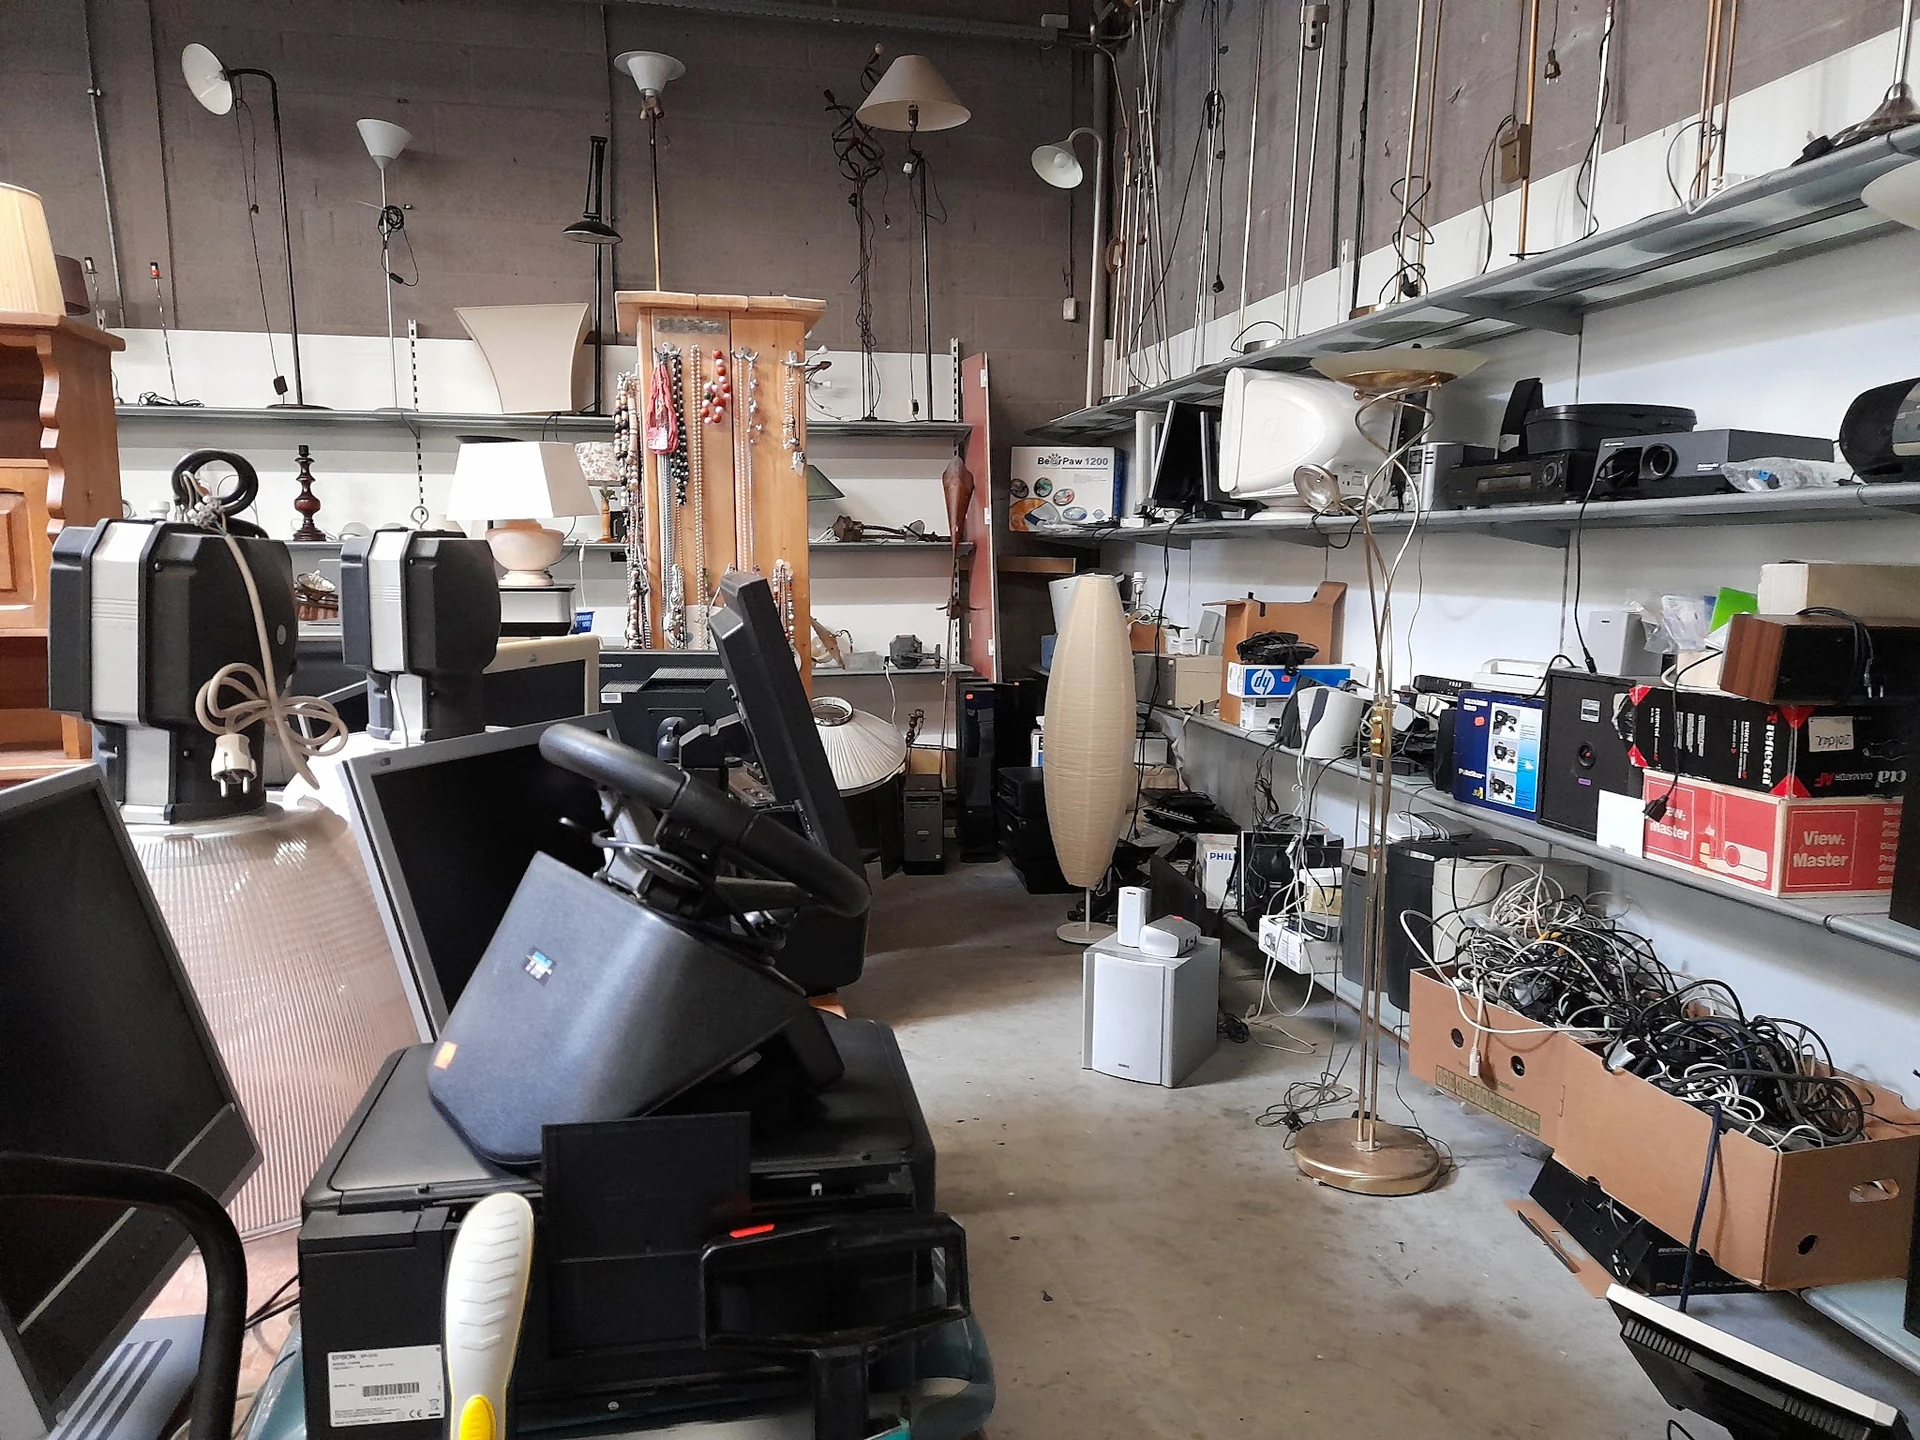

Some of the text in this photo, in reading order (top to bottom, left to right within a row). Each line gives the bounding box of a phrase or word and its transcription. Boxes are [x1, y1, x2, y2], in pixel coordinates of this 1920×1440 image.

[1085, 457, 1109, 466] 1200
[1761, 724, 1776, 787] reflecta
[1649, 822, 1690, 841] Master
[1209, 852, 1233, 861] PHIL
[1793, 852, 1849, 868] Master
